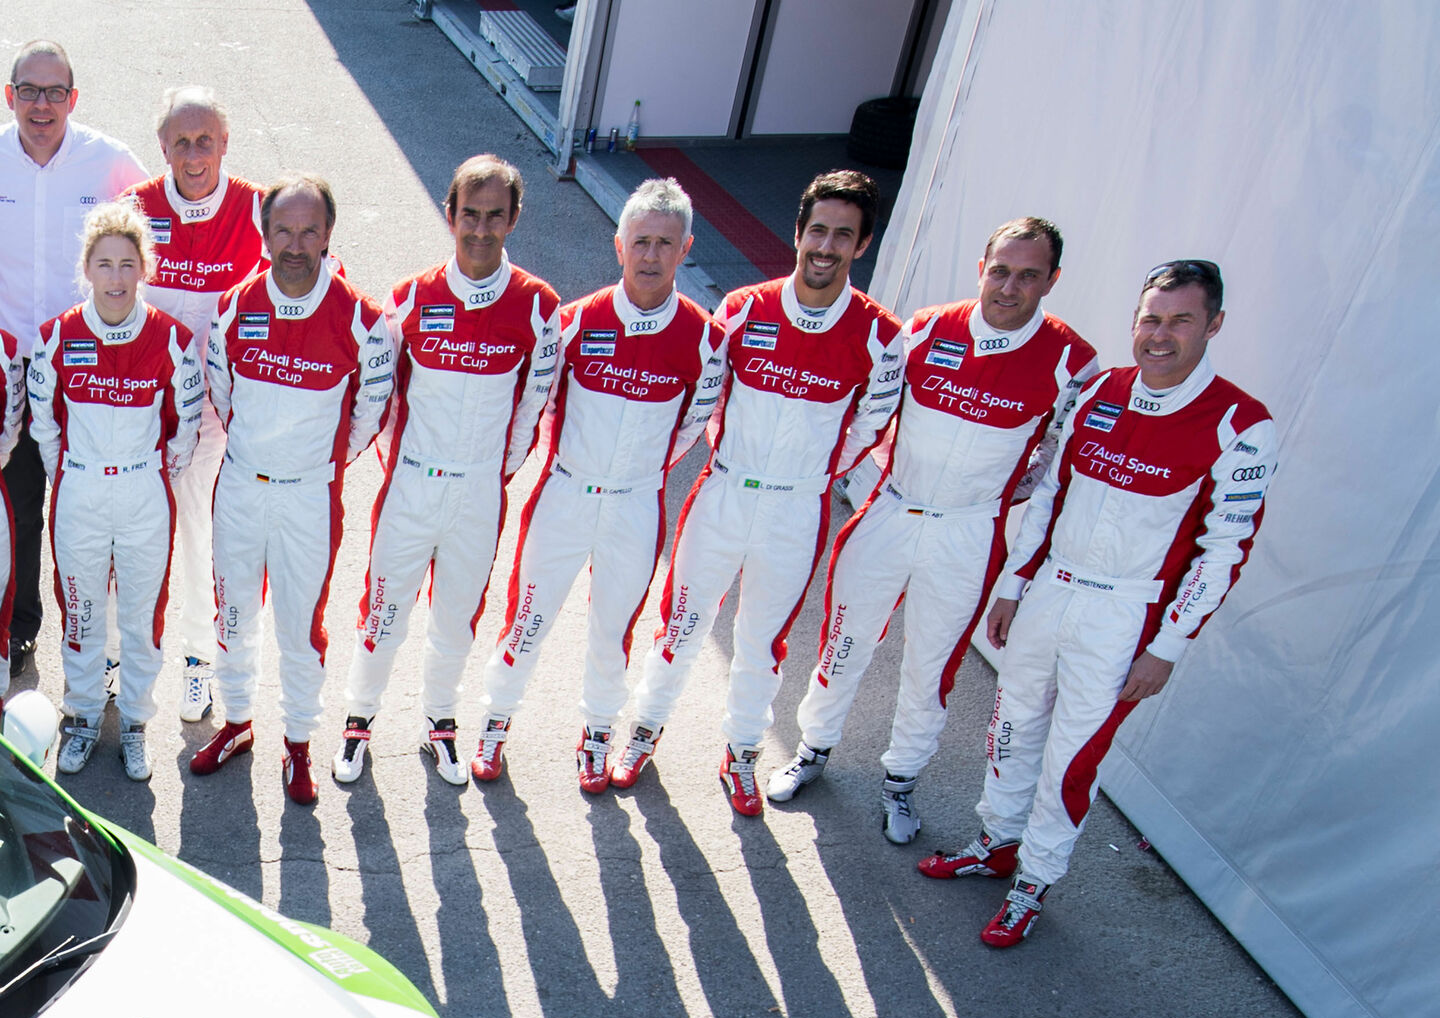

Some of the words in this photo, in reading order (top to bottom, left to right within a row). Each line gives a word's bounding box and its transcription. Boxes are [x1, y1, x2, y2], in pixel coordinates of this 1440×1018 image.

[160, 260, 193, 272] Audi
[196, 262, 233, 276] Sport
[160, 271, 177, 282] TT
[180, 274, 205, 288] Cup
[440, 340, 475, 353] Audi
[479, 343, 516, 356] Sport
[258, 350, 290, 365] Audi
[293, 358, 332, 373] Sport
[439, 354, 456, 365] TT
[461, 356, 488, 370] Cup
[88, 375, 119, 387] Audi
[123, 378, 158, 390] Sport
[257, 364, 273, 375] TT
[277, 368, 302, 384] Cup
[603, 364, 636, 380] Audi
[640, 371, 679, 385] Sport
[761, 374, 779, 387] TT
[783, 381, 808, 396] Cup
[763, 361, 797, 379] Audi
[800, 372, 841, 390] Sport
[88, 388, 105, 398] TT
[109, 390, 133, 403] Cup
[602, 378, 617, 389] TT
[622, 383, 648, 396] Cup
[941, 381, 978, 400] Audi
[983, 393, 1025, 412] Sport
[938, 394, 956, 408] TT
[960, 401, 988, 419] Cup
[132, 462, 148, 471] FREY
[1089, 459, 1107, 474] TT
[1109, 468, 1133, 486] Cup
[1095, 447, 1125, 465] Audi
[1126, 458, 1171, 479] Sport
[67, 576, 77, 609] Sport
[372, 576, 385, 612] Sport
[1077, 578, 1114, 591] KRISTENSEN
[1176, 589, 1192, 611] Audi
[1188, 560, 1207, 587] Sport
[673, 585, 688, 622] Sport
[1183, 601, 1194, 614] TT
[1192, 582, 1207, 600] Cup
[82, 600, 93, 623] Cup
[227, 606, 240, 627] Cup
[383, 603, 398, 626] Cup
[509, 624, 523, 652] Audi
[519, 583, 536, 622] Sport
[69, 610, 77, 641] Audi
[81, 626, 91, 640] TT
[520, 637, 531, 653] TT
[527, 614, 544, 636] Cup
[683, 612, 701, 636] Cup
[821, 644, 835, 674] Audi
[830, 604, 846, 642] Sport
[837, 636, 855, 659] Cup
[832, 662, 844, 676] TT
[985, 733, 995, 761] Audi
[990, 687, 1002, 729] Sport
[998, 721, 1014, 744] Cup
[999, 747, 1010, 761] TT
